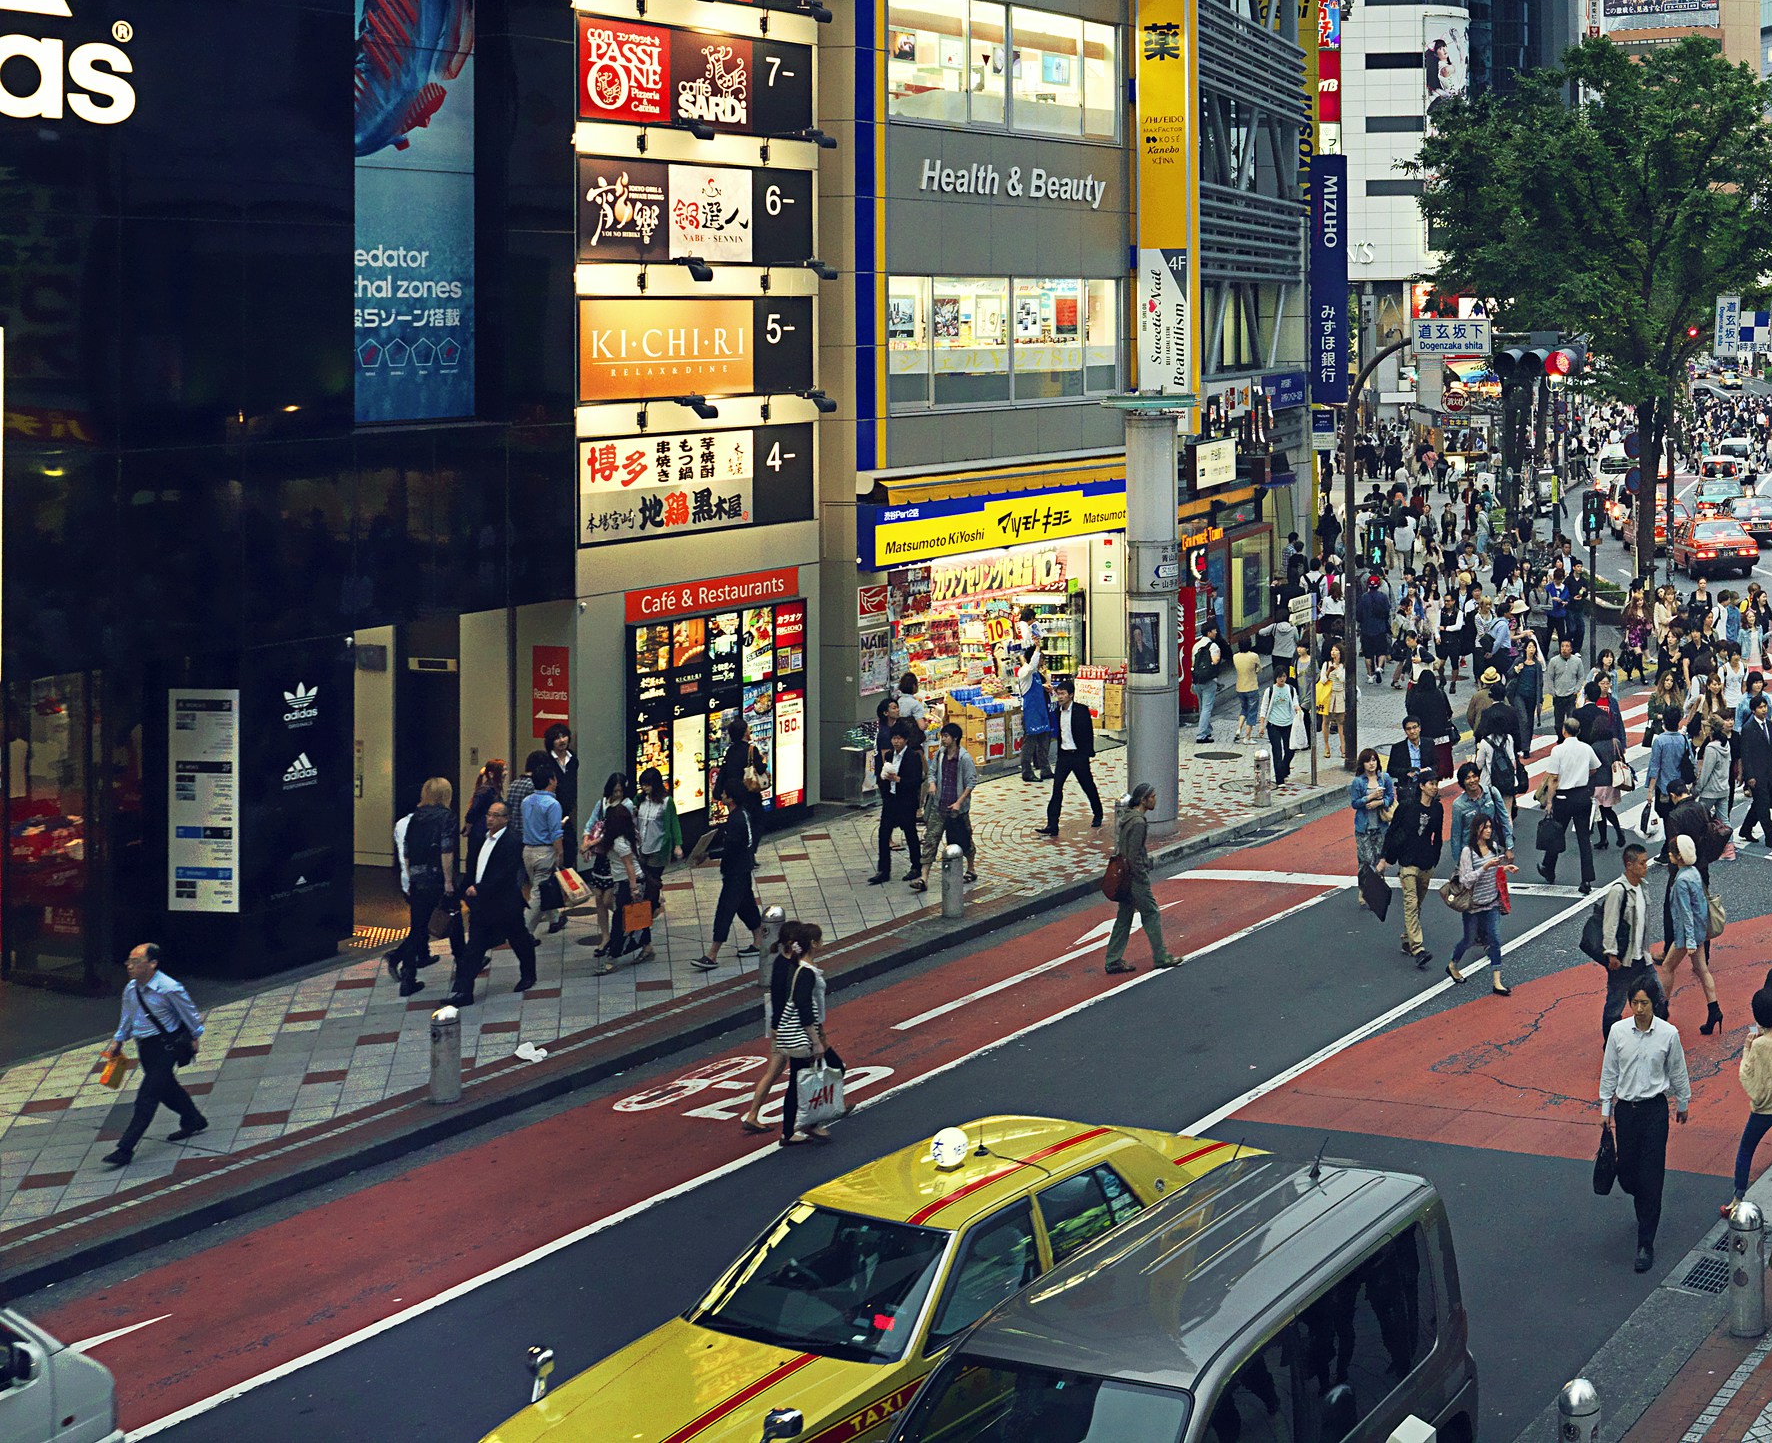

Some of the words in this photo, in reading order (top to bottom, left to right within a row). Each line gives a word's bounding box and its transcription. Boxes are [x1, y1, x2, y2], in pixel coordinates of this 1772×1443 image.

[1144, 23, 1180, 61] 薬
[630, 87, 660, 101] Pizzeria
[678, 79, 712, 98] caffé
[630, 101, 660, 114] Cantina
[678, 97, 747, 126] SARDi
[1142, 115, 1184, 124] SHISEIDO
[1147, 145, 1180, 155] Kanebo
[920, 158, 999, 197] Health
[1008, 168, 1024, 197] &
[1030, 168, 1106, 209] Beauty
[673, 199, 749, 231] 鍋選人
[1323, 175, 1338, 248] MIZUHO
[683, 234, 705, 242] NABE
[713, 235, 744, 243] SENNIN
[1169, 256, 1187, 271] 4F
[354, 275, 392, 298] hal
[397, 281, 462, 298] zones
[1150, 269, 1162, 304] Nail
[1151, 310, 1162, 365] Sweetie
[1418, 324, 1484, 340] 道玄坂下
[1725, 302, 1737, 352] 道玄坂下
[1174, 303, 1185, 387] Beautilism
[1320, 305, 1337, 384] みずほ銀行
[1420, 341, 1461, 351] Dogenzaka
[1465, 341, 1483, 350] shita
[1740, 342, 1768, 352] 時差式
[587, 443, 648, 487] 博多
[656, 440, 671, 482] 串焼き
[678, 439, 693, 480] もつ鍋
[700, 437, 715, 478] 芋焼酎
[997, 507, 1072, 539] マツモトキヨシ
[885, 537, 947, 555] Matsumoto
[948, 528, 985, 544] KiYoshi
[641, 591, 676, 614] Café
[681, 589, 694, 607] &
[699, 577, 785, 605] Restaurants
[776, 613, 802, 624] カラオケ
[540, 664, 561, 677] Café
[533, 688, 568, 702] Restaurants
[283, 708, 318, 722] adidas
[283, 768, 318, 782] adidas
[849, 1395, 904, 1433] TAXI
